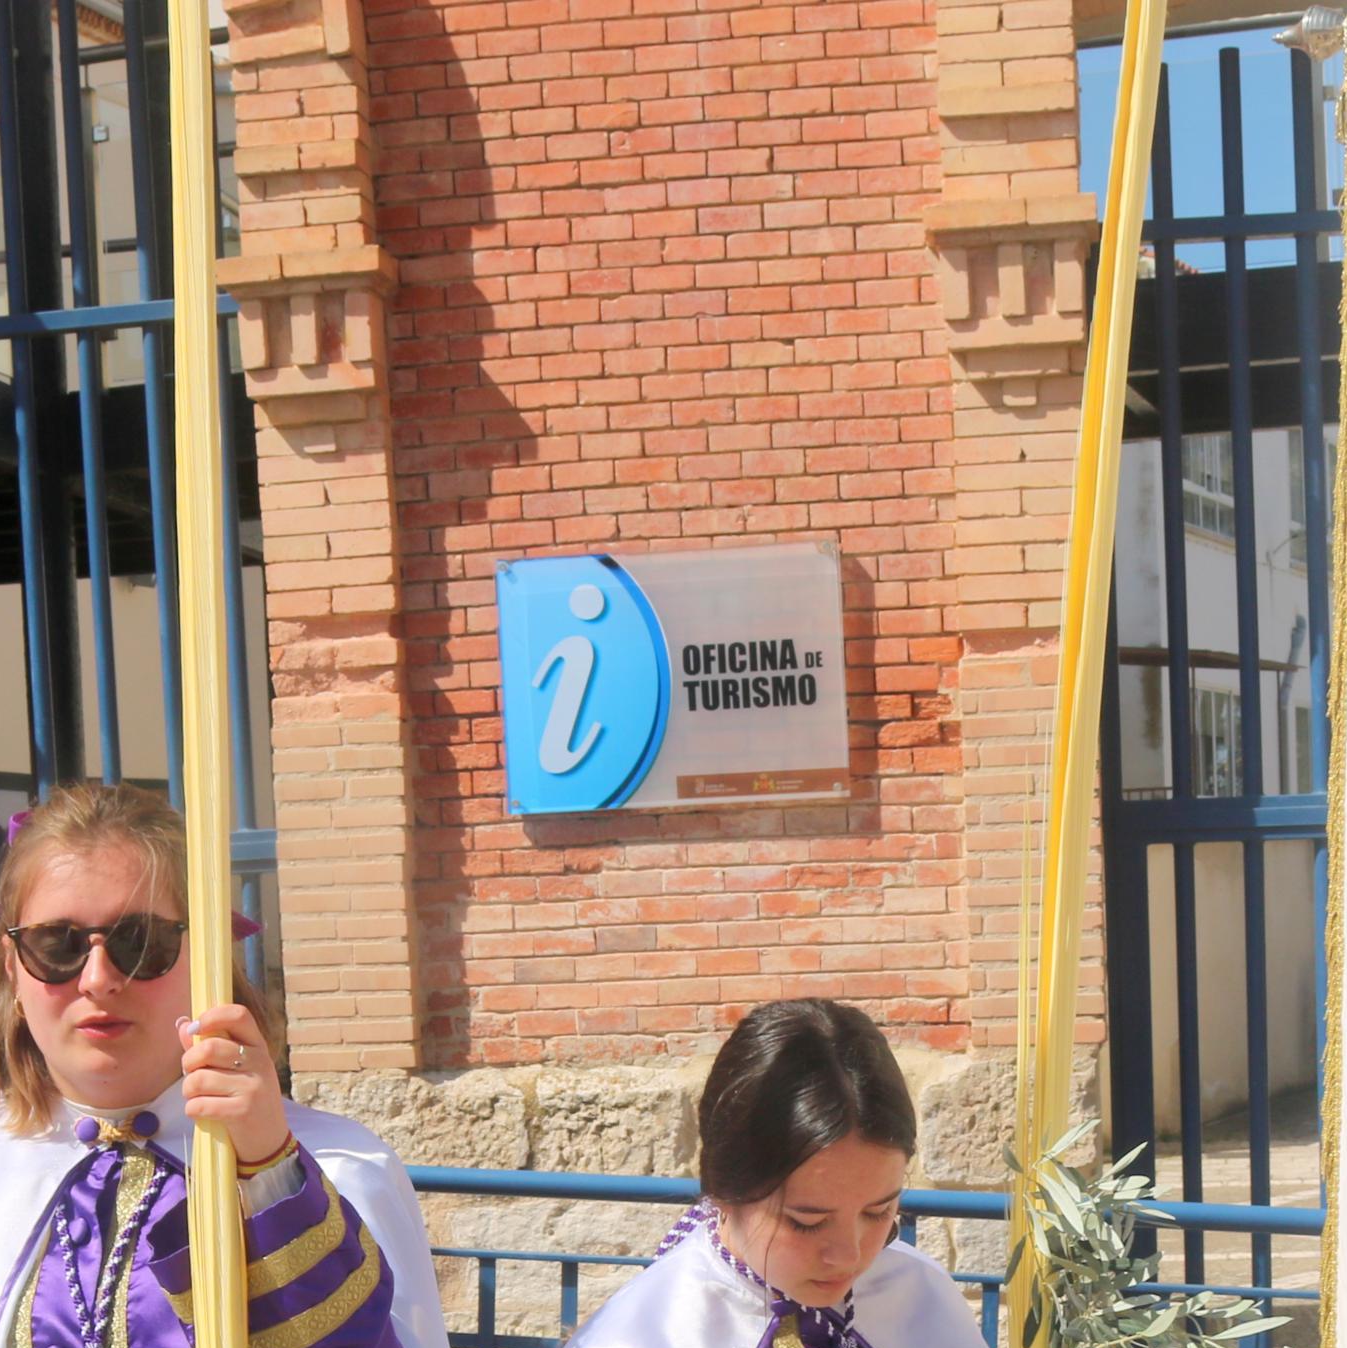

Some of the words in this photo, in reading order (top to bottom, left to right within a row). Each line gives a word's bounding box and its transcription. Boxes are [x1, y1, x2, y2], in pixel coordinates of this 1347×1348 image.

[682, 639, 798, 676] OFICINA
[804, 650, 823, 668] DE
[682, 674, 818, 711] TURISMO
